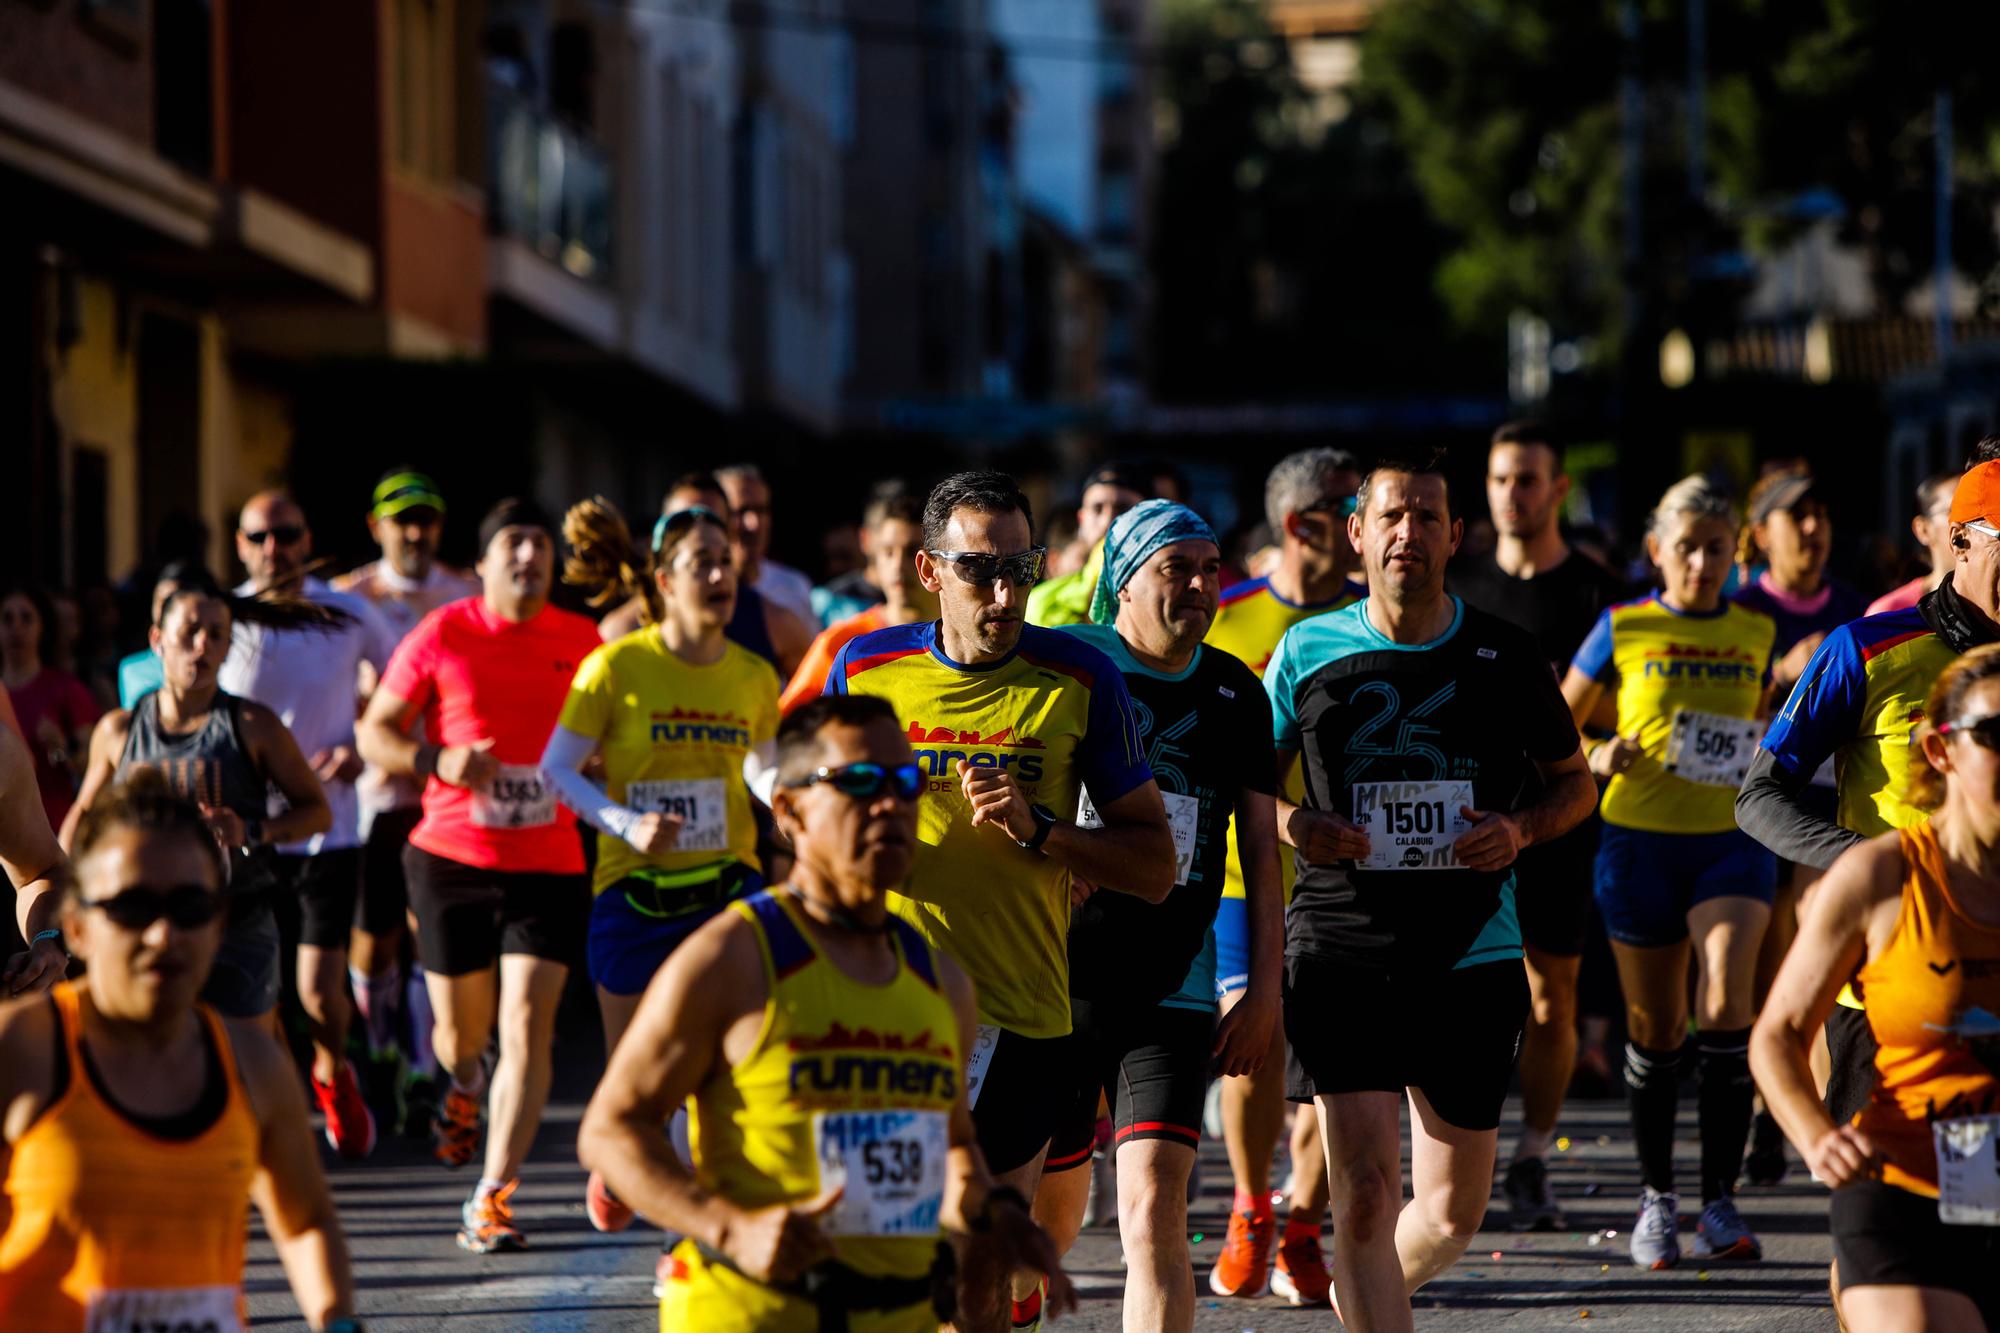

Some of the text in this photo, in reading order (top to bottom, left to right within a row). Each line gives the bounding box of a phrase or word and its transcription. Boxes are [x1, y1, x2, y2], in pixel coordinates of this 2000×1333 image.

[1645, 662, 1757, 679] runners
[651, 723, 750, 746] runners
[1695, 729, 1737, 760] 505
[914, 750, 1044, 782] nners
[929, 781, 952, 793] DE
[1383, 801, 1445, 834] 1501
[1396, 837, 1433, 846] CALABUIG
[790, 1057, 957, 1098] runners
